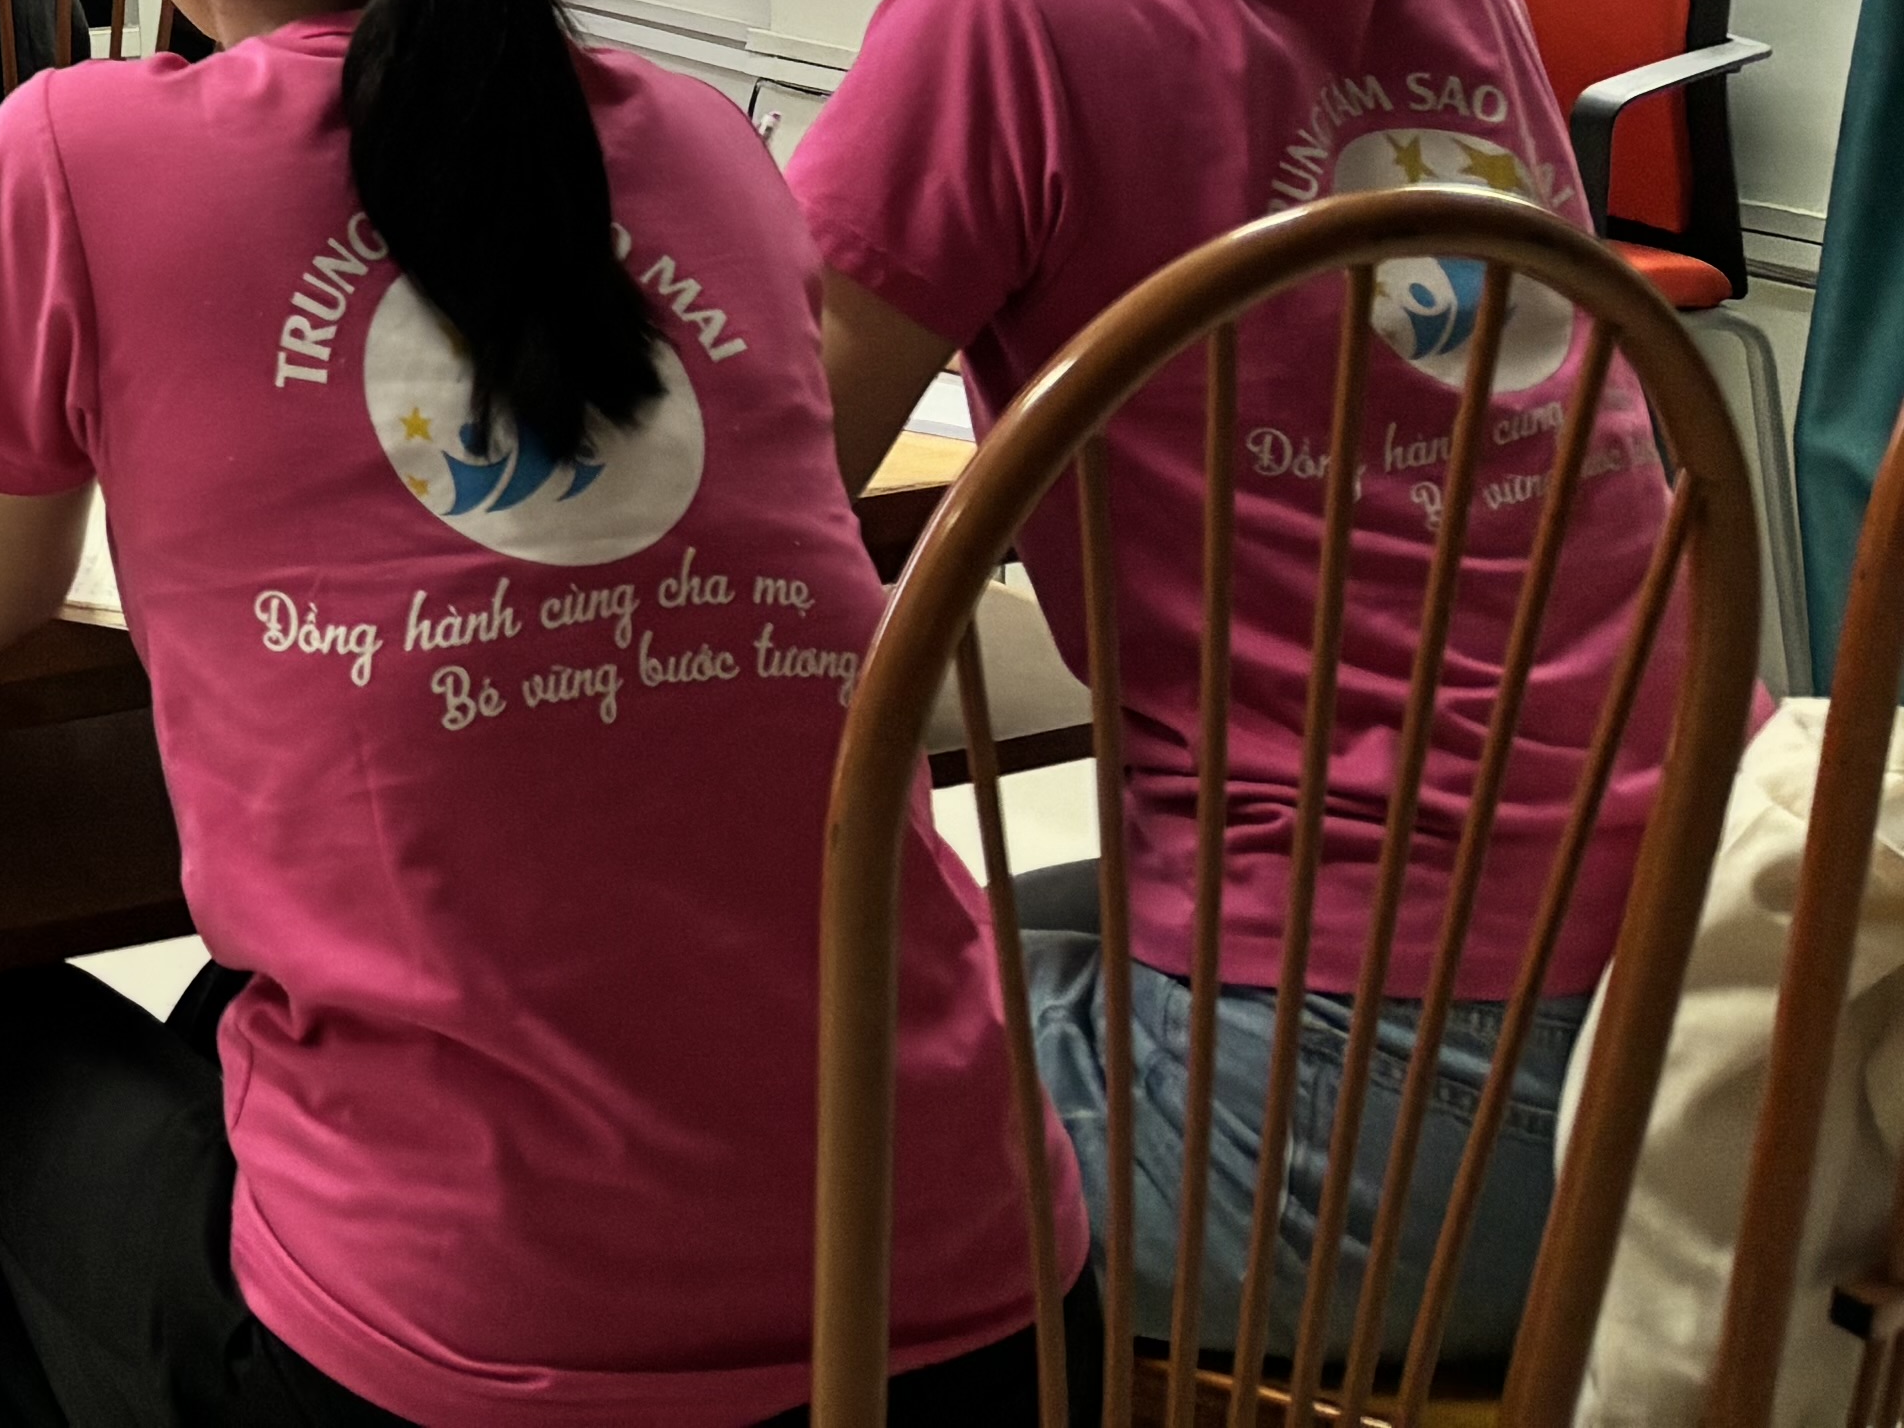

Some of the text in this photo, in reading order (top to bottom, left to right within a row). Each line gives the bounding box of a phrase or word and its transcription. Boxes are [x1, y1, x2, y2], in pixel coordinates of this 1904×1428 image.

[1406, 72, 1509, 124] SAO
[275, 211, 749, 388] TRUNG MAI
[253, 546, 815, 688] Đồng hành cùng cha mẹ
[431, 665, 507, 732] Bé
[522, 661, 625, 726] vững
